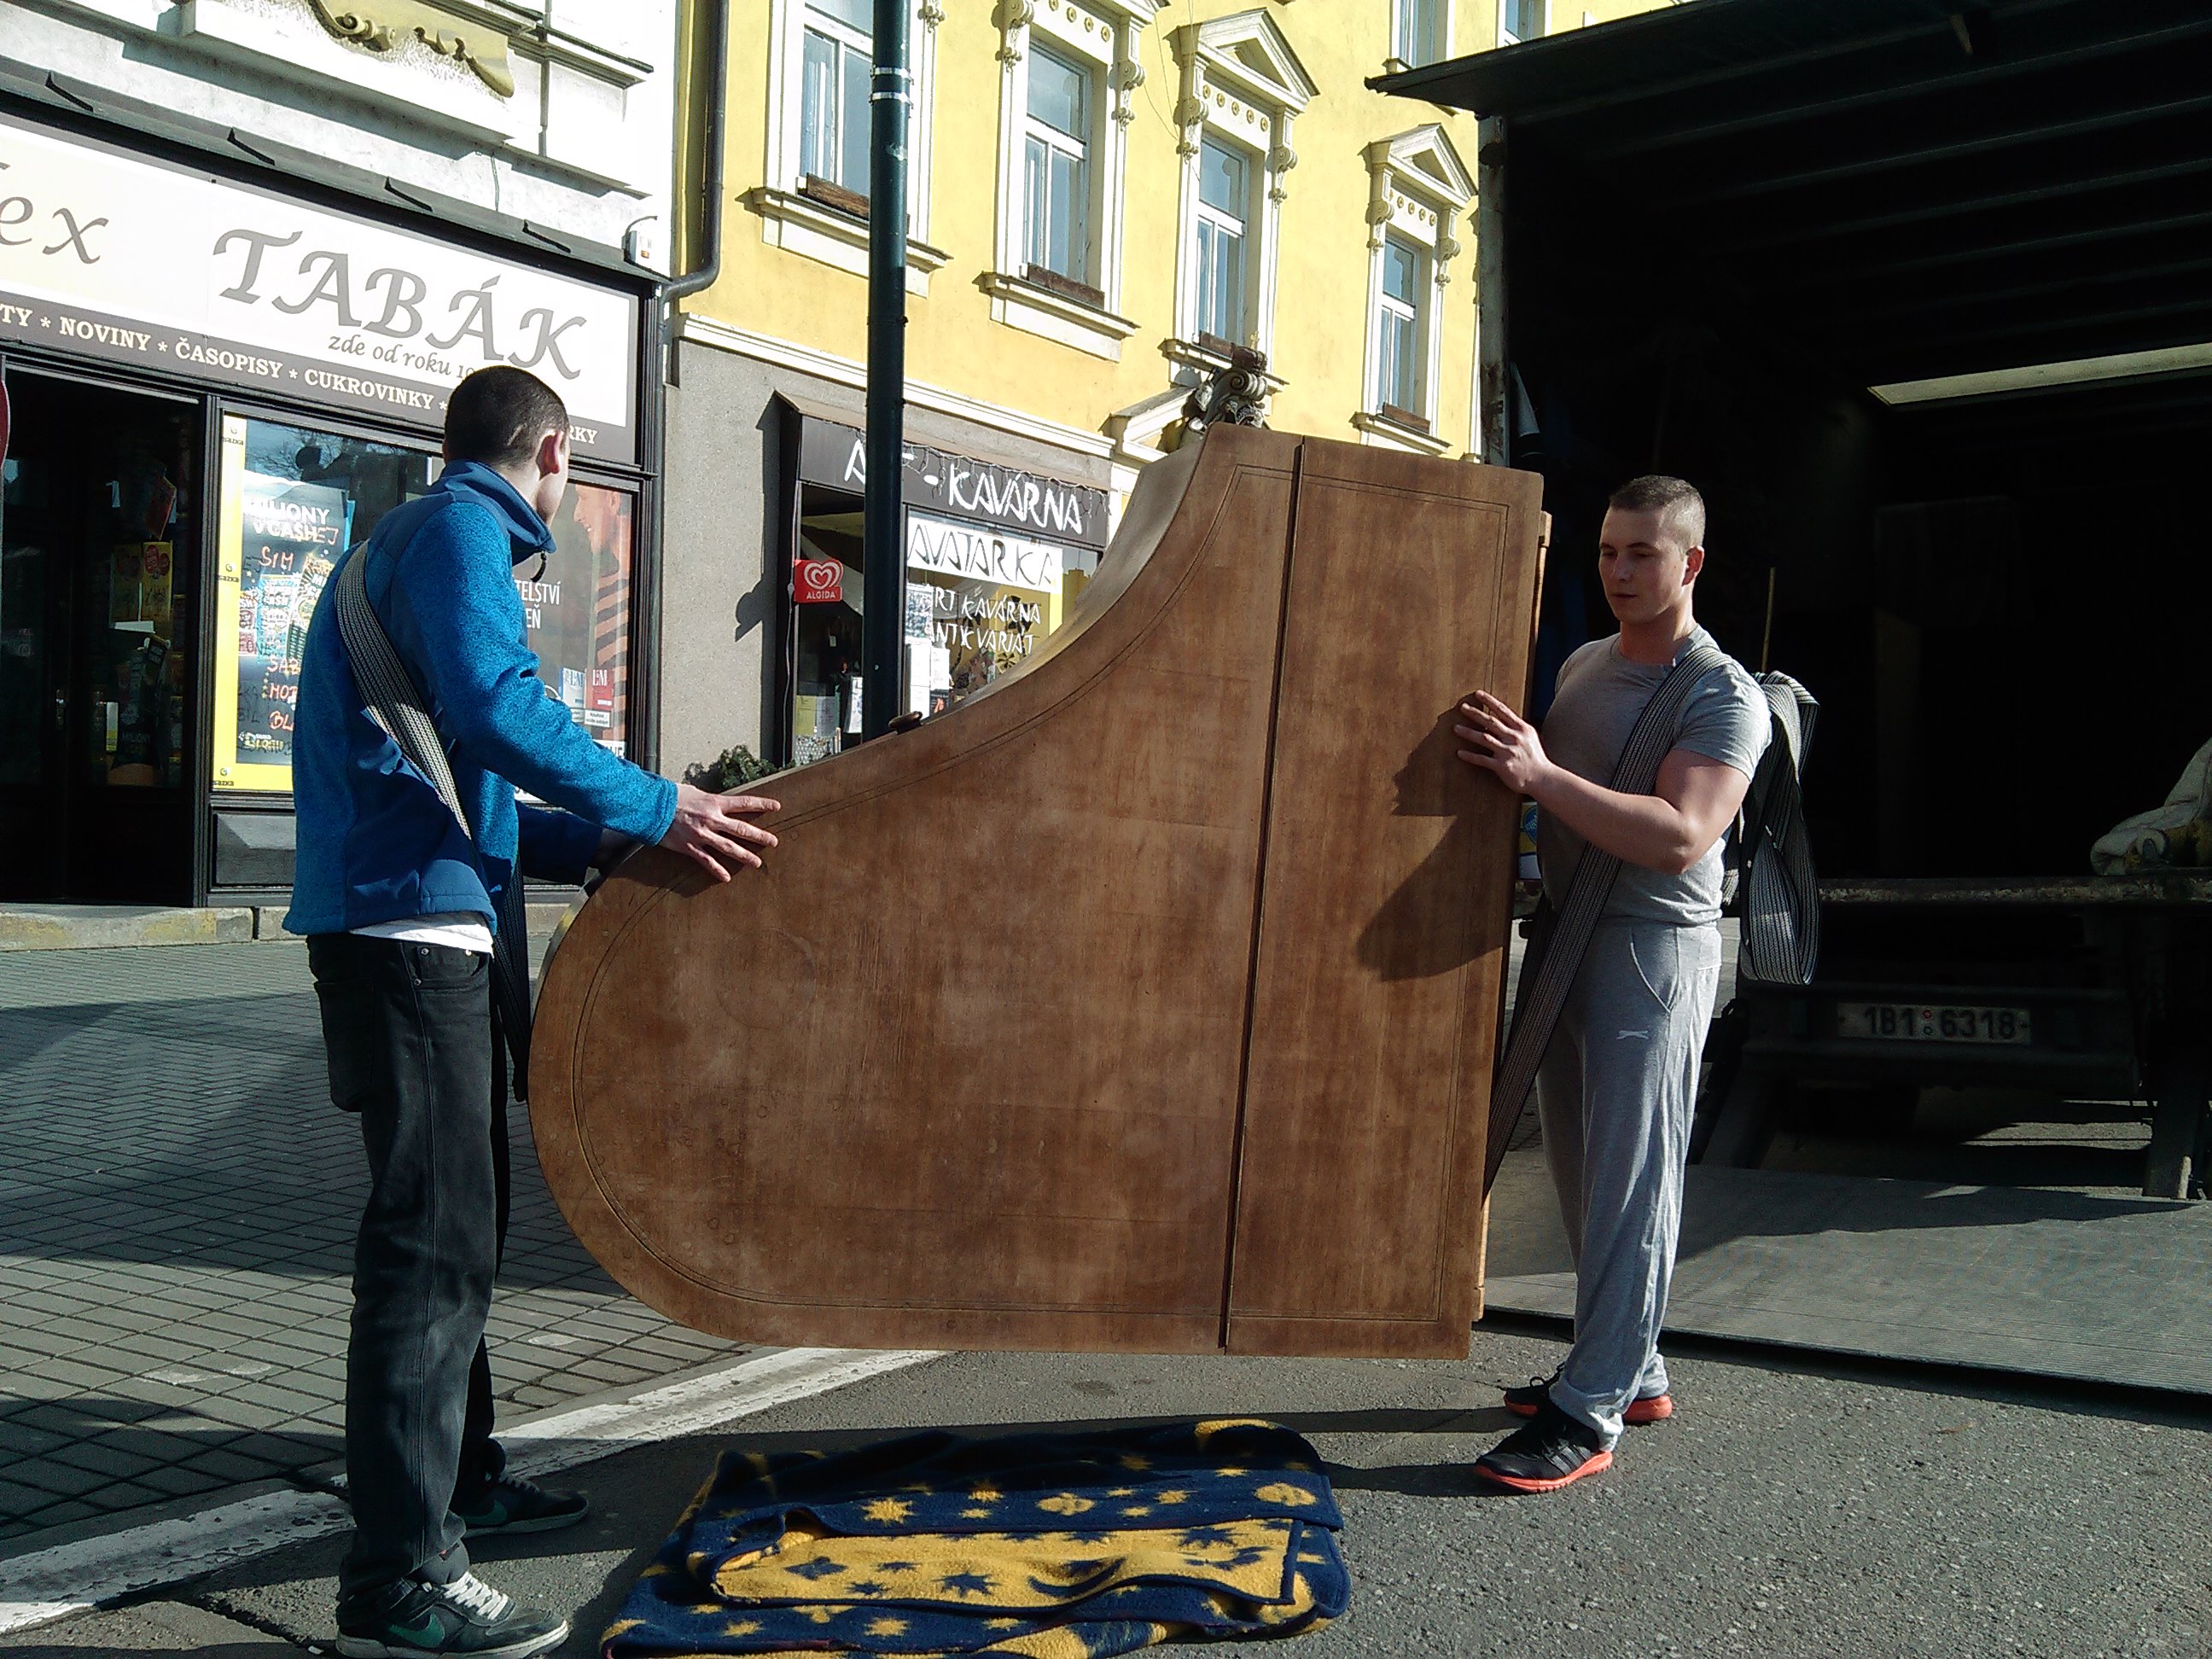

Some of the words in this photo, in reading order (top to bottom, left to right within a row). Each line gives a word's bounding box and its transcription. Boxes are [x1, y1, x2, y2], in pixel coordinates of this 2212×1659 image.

[0, 195, 109, 265] ex
[212, 228, 587, 380] TABÁK
[328, 333, 365, 356] zde
[372, 343, 404, 364] od
[403, 351, 452, 376] roku
[59, 316, 151, 352] NOVINY
[174, 336, 284, 379] ČASOPISY
[304, 368, 435, 410] CUKROVINKY
[568, 424, 597, 445] RKY
[948, 463, 1083, 535] KAVÁRNA
[259, 545, 294, 573] SIM
[907, 523, 1056, 586] AVATARKA
[515, 579, 562, 605] TELSTVÍ
[806, 590, 836, 600] ALGIDA
[934, 586, 957, 612] RT
[961, 593, 1041, 625] KAVÁRNA
[1864, 1006, 1913, 1037] 1B1
[1940, 1009, 2017, 1039] 6318
